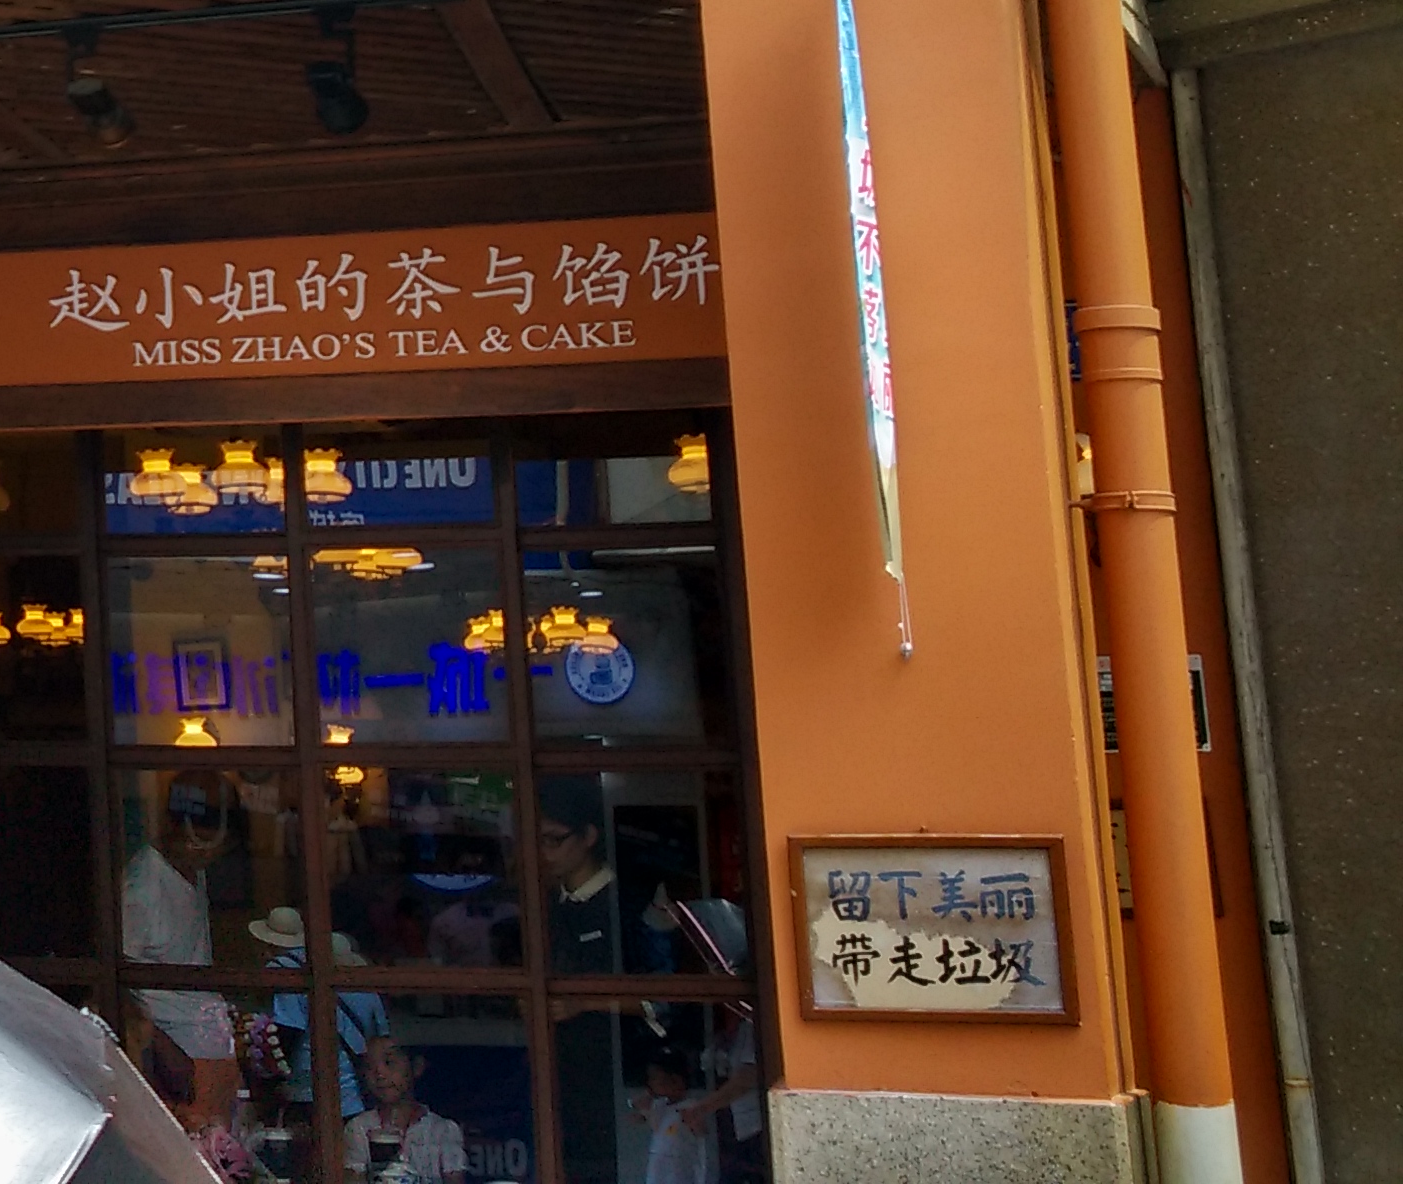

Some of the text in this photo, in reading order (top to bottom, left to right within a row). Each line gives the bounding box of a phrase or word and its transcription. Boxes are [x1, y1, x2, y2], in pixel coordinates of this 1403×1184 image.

[49, 235, 719, 331] 赵小姐的茶与馅饼
[132, 339, 221, 367] MISS
[388, 329, 468, 357] TEA
[480, 326, 512, 353] &
[521, 320, 636, 351] CAKE
[828, 870, 1036, 923] 留下美丽
[832, 933, 1046, 987] 带走垃圾
